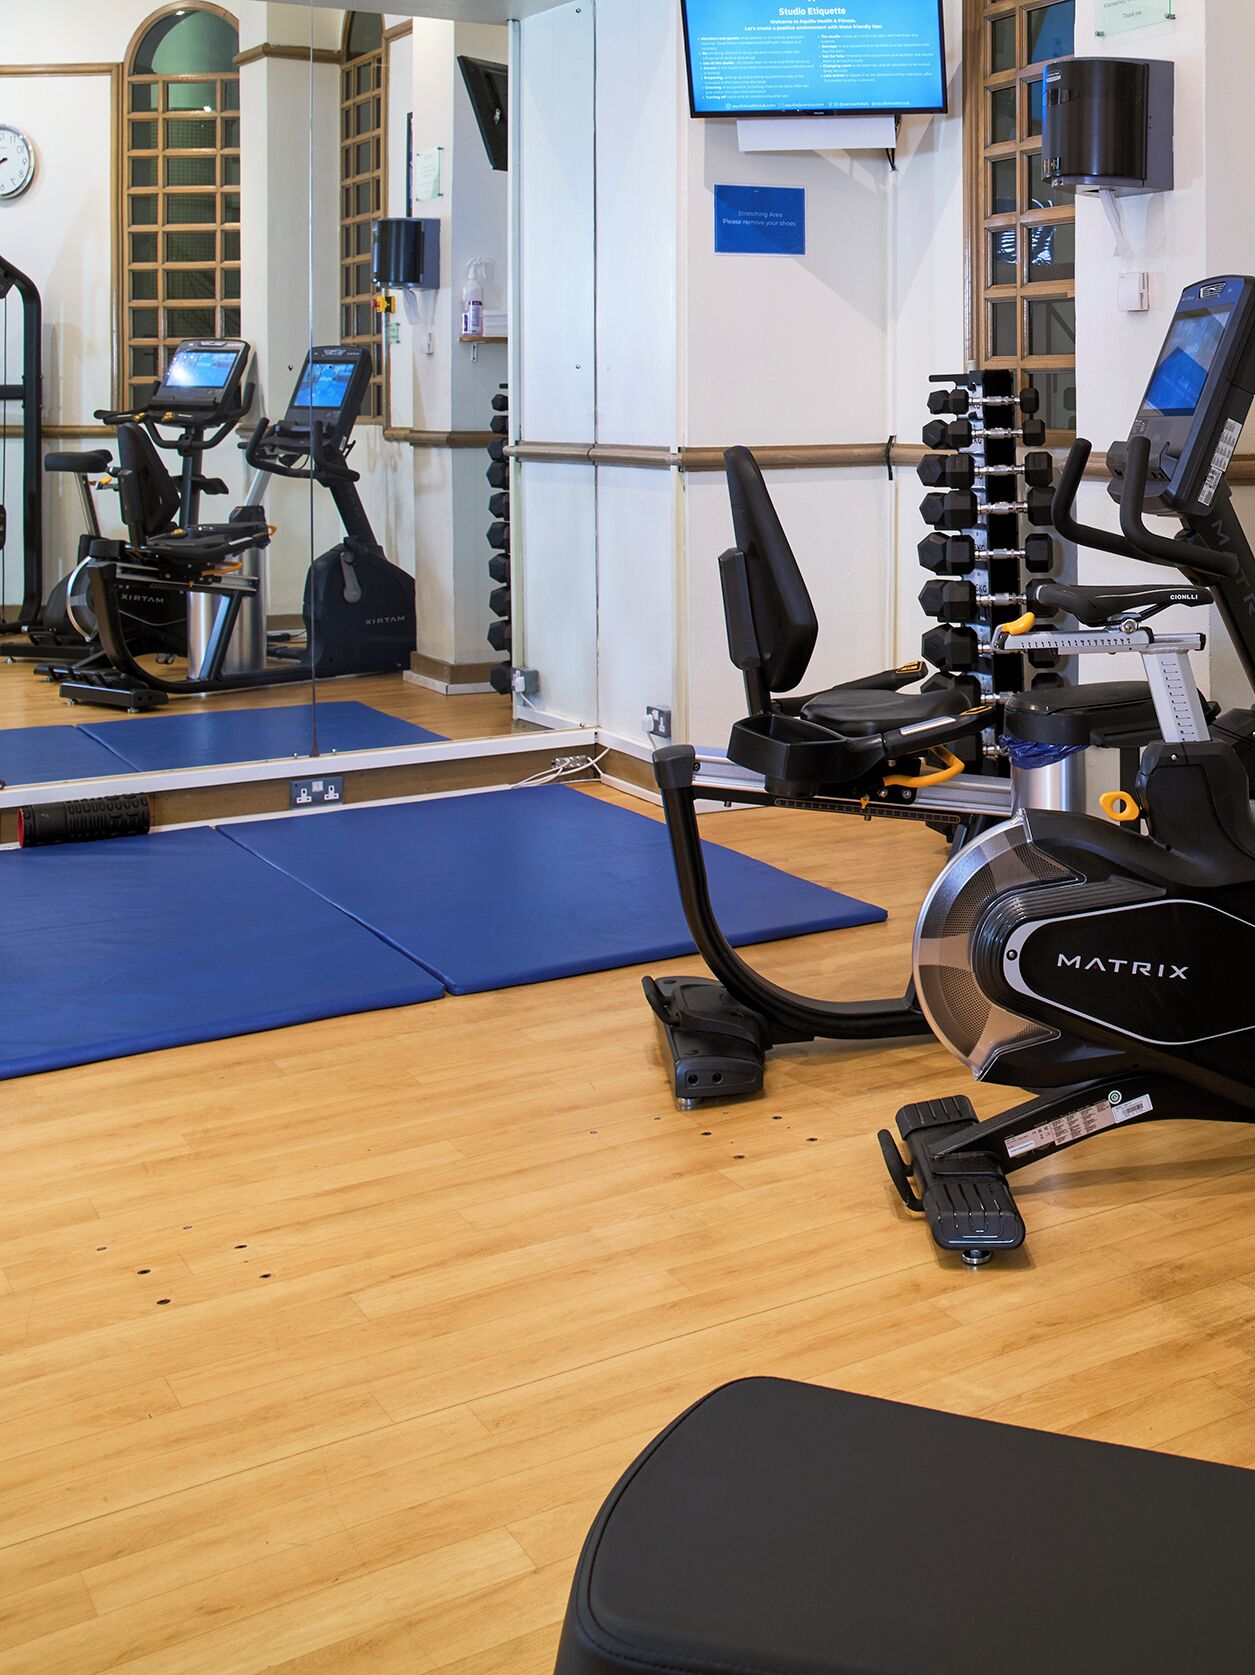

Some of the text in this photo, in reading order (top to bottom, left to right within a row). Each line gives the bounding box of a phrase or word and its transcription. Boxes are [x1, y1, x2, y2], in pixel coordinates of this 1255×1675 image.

[778, 7, 847, 17] Studio Etiquette
[738, 210, 768, 218] Stretching
[1057, 953, 1189, 980] MATRIX
